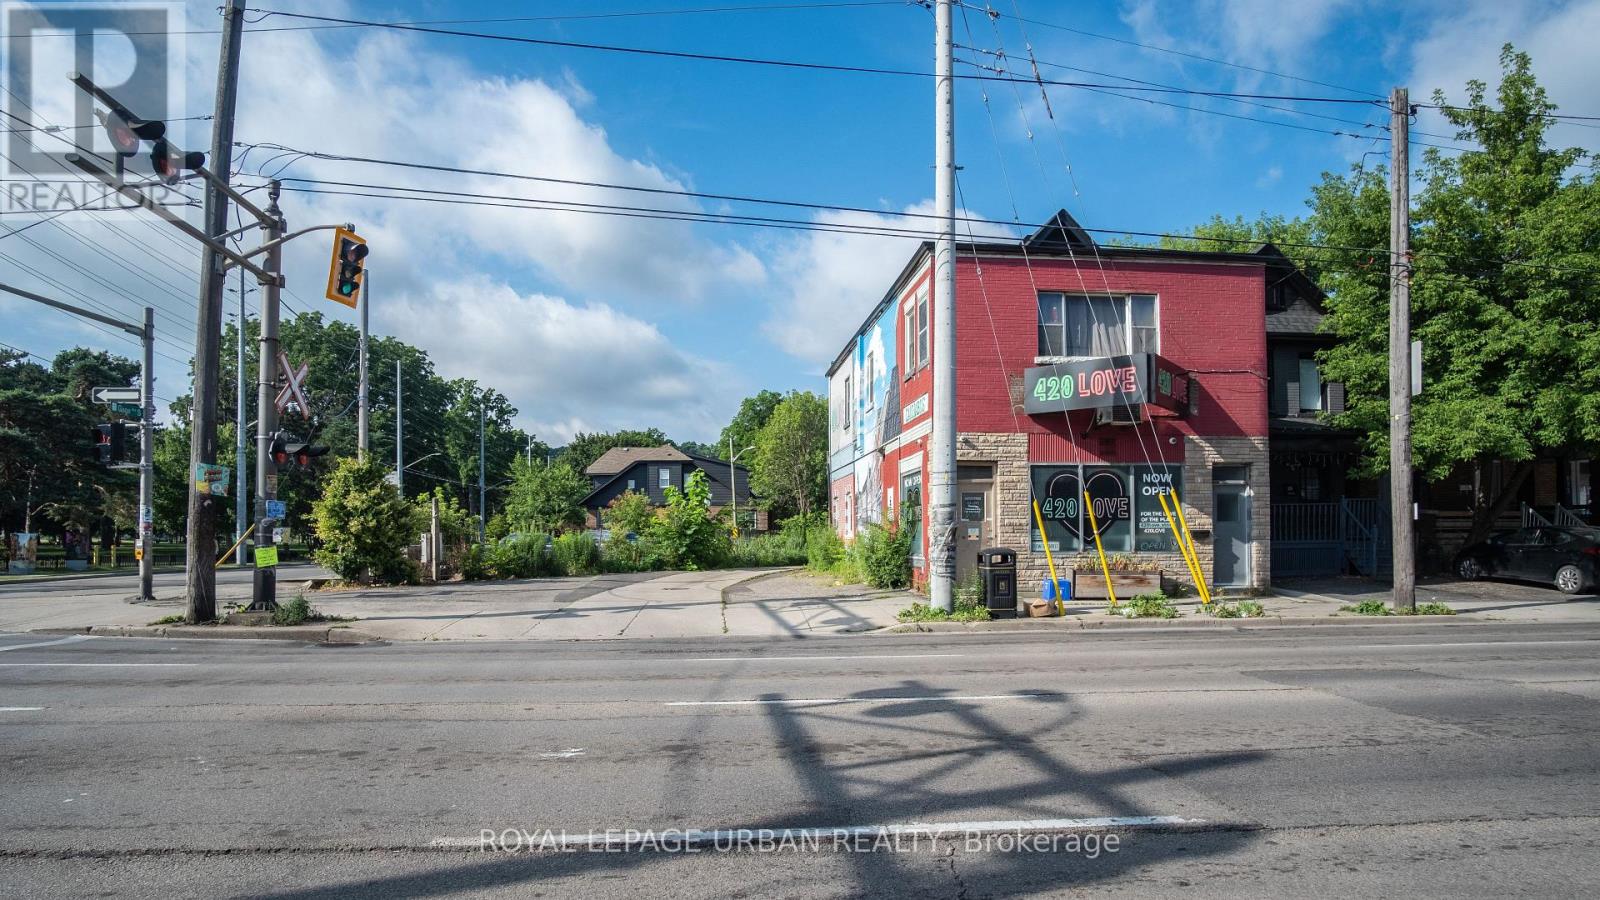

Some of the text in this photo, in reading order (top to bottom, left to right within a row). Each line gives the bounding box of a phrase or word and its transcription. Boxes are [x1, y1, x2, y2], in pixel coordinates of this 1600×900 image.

[1034, 366, 1136, 401] 420 LOVE
[1142, 473, 1173, 483] NOW
[1042, 498, 1077, 518] 420
